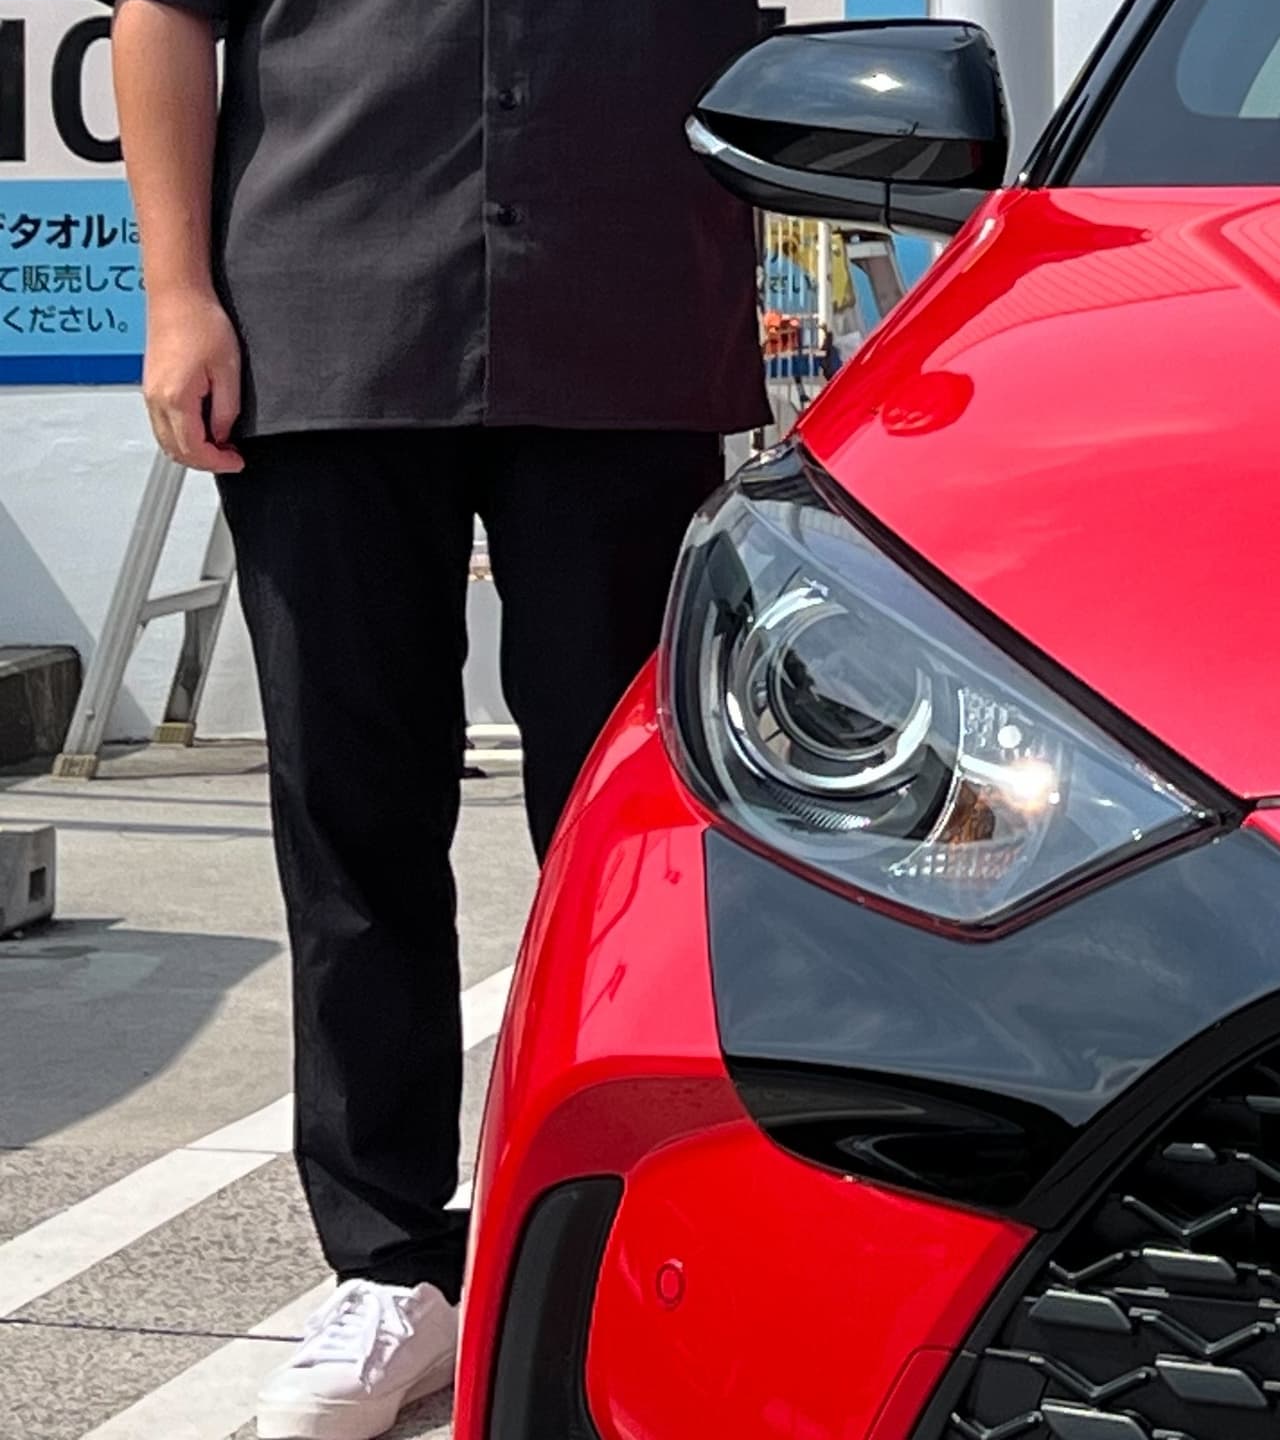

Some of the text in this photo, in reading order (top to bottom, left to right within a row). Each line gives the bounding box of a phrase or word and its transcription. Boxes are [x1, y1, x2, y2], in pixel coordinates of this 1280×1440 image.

[0, 212, 140, 249] タオルは
[3, 305, 128, 333] ください。
